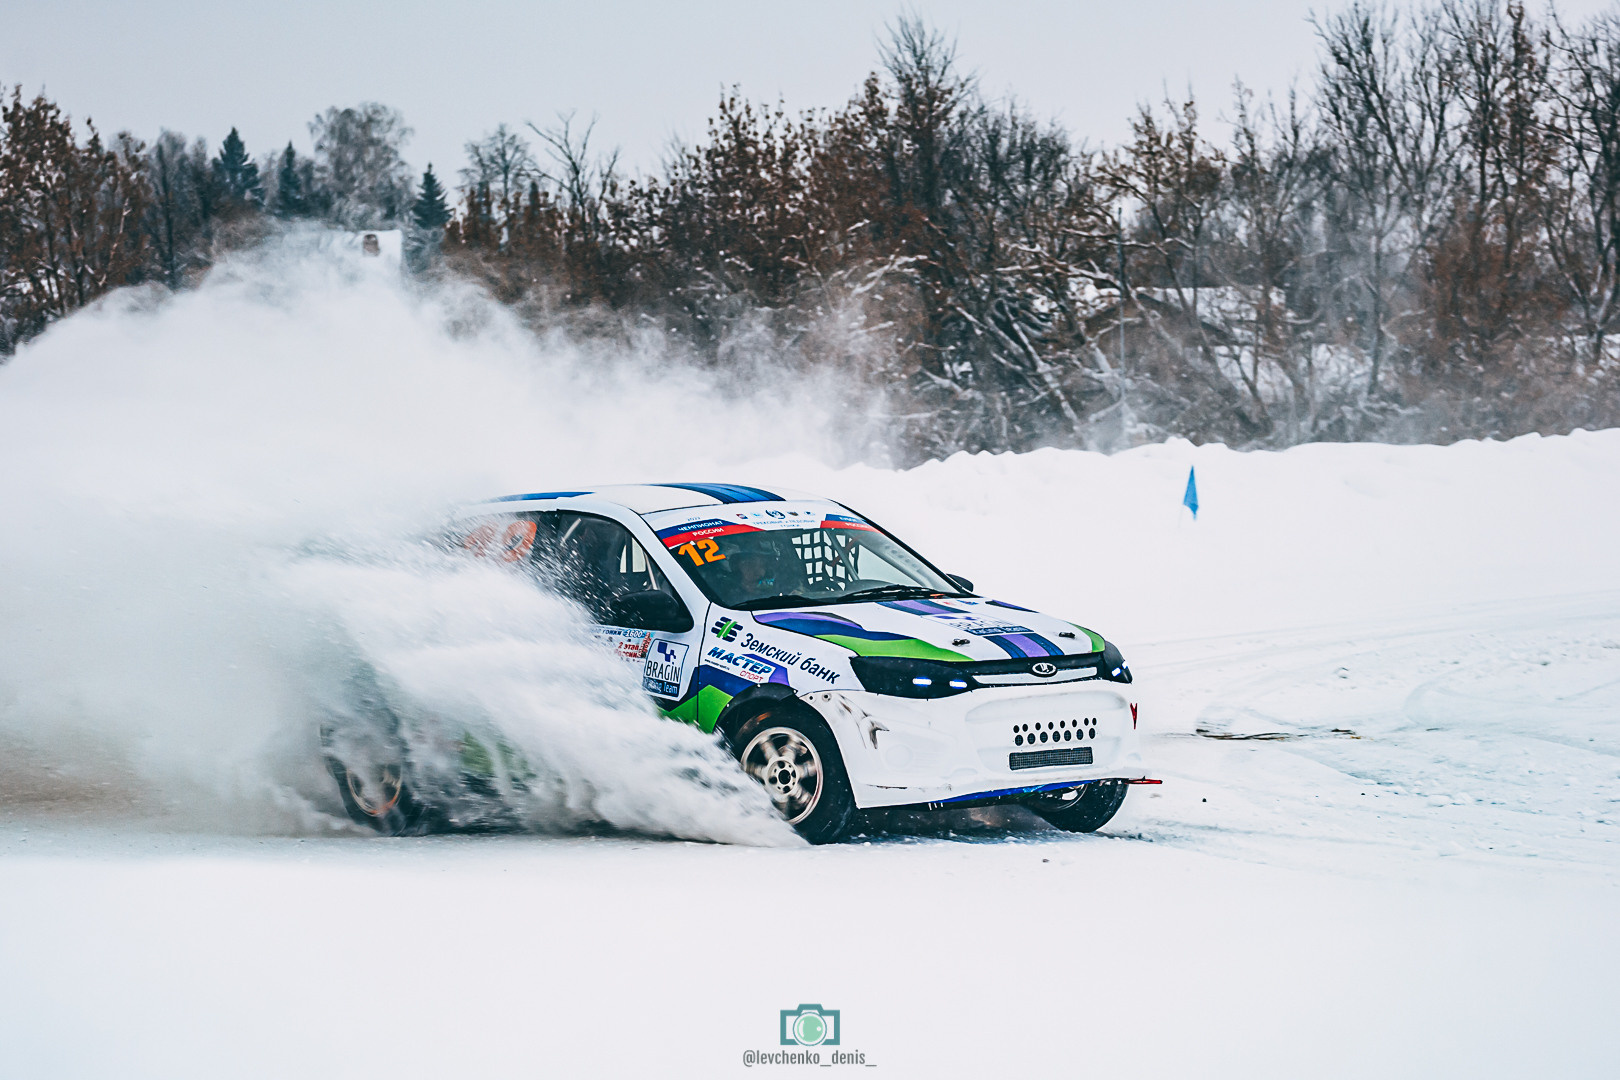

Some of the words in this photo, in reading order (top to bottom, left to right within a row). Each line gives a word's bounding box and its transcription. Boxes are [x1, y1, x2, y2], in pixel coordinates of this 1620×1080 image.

[677, 520, 723, 532] ЧЕМПИОНАТ
[692, 527, 725, 537] РОССИИ
[678, 538, 727, 567] 12
[707, 646, 773, 675] МАСТЕР
[740, 632, 803, 666] Земский
[799, 657, 841, 685] банк
[739, 670, 764, 683] СПОРТ
[663, 681, 678, 695] Team
